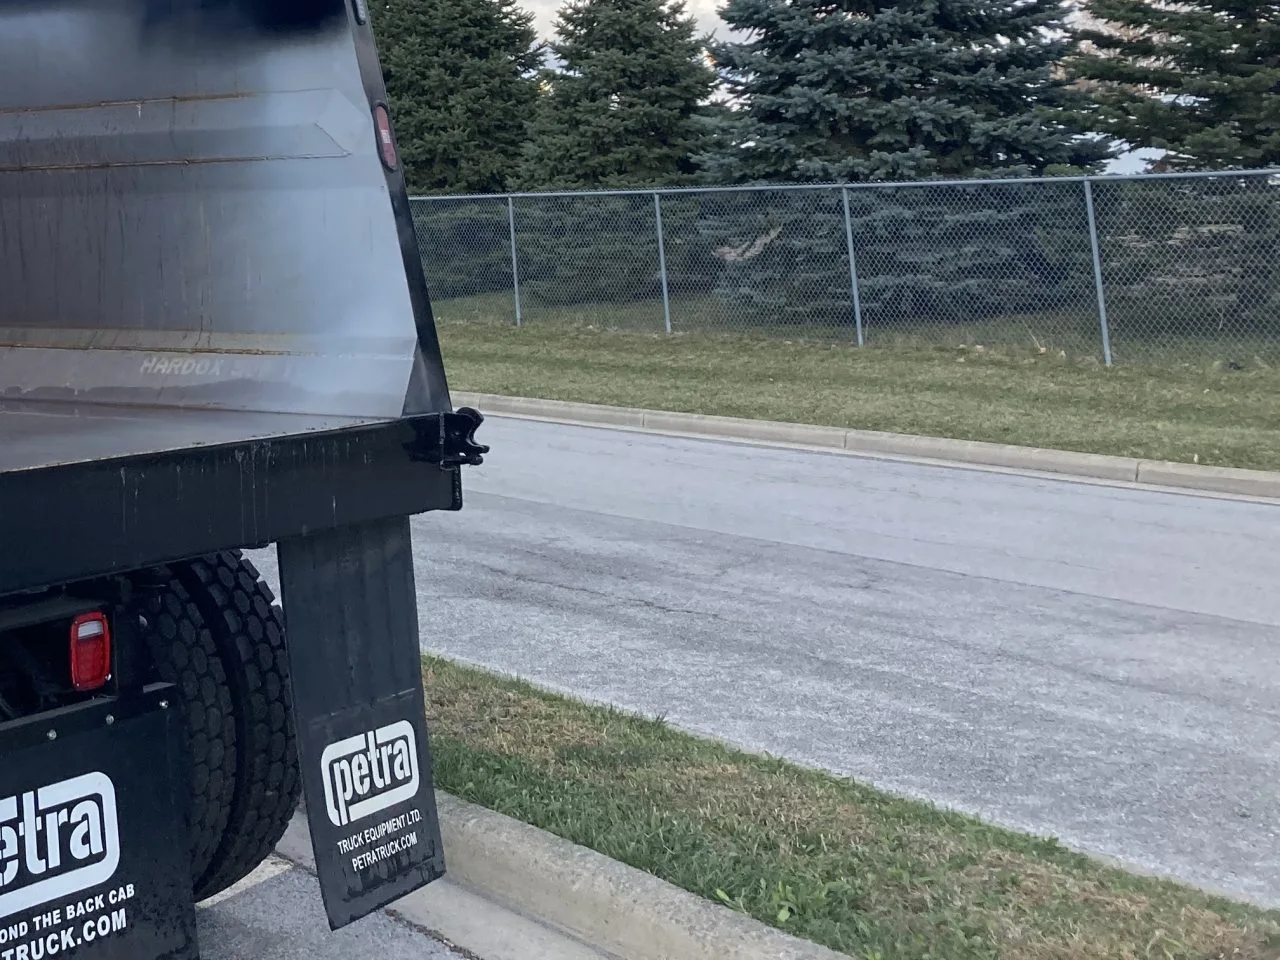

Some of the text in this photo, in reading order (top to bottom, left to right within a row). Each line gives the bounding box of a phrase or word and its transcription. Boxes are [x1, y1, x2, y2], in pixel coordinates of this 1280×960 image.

[140, 357, 224, 377] HARDOX
[333, 730, 411, 826] petra
[337, 832, 365, 855] TRUCK
[364, 814, 406, 843] EQUIPMENT
[352, 831, 418, 872] PETRATRUCK.COM
[33, 909, 62, 931] THE
[66, 893, 106, 920] BACK
[108, 883, 135, 905] CAB
